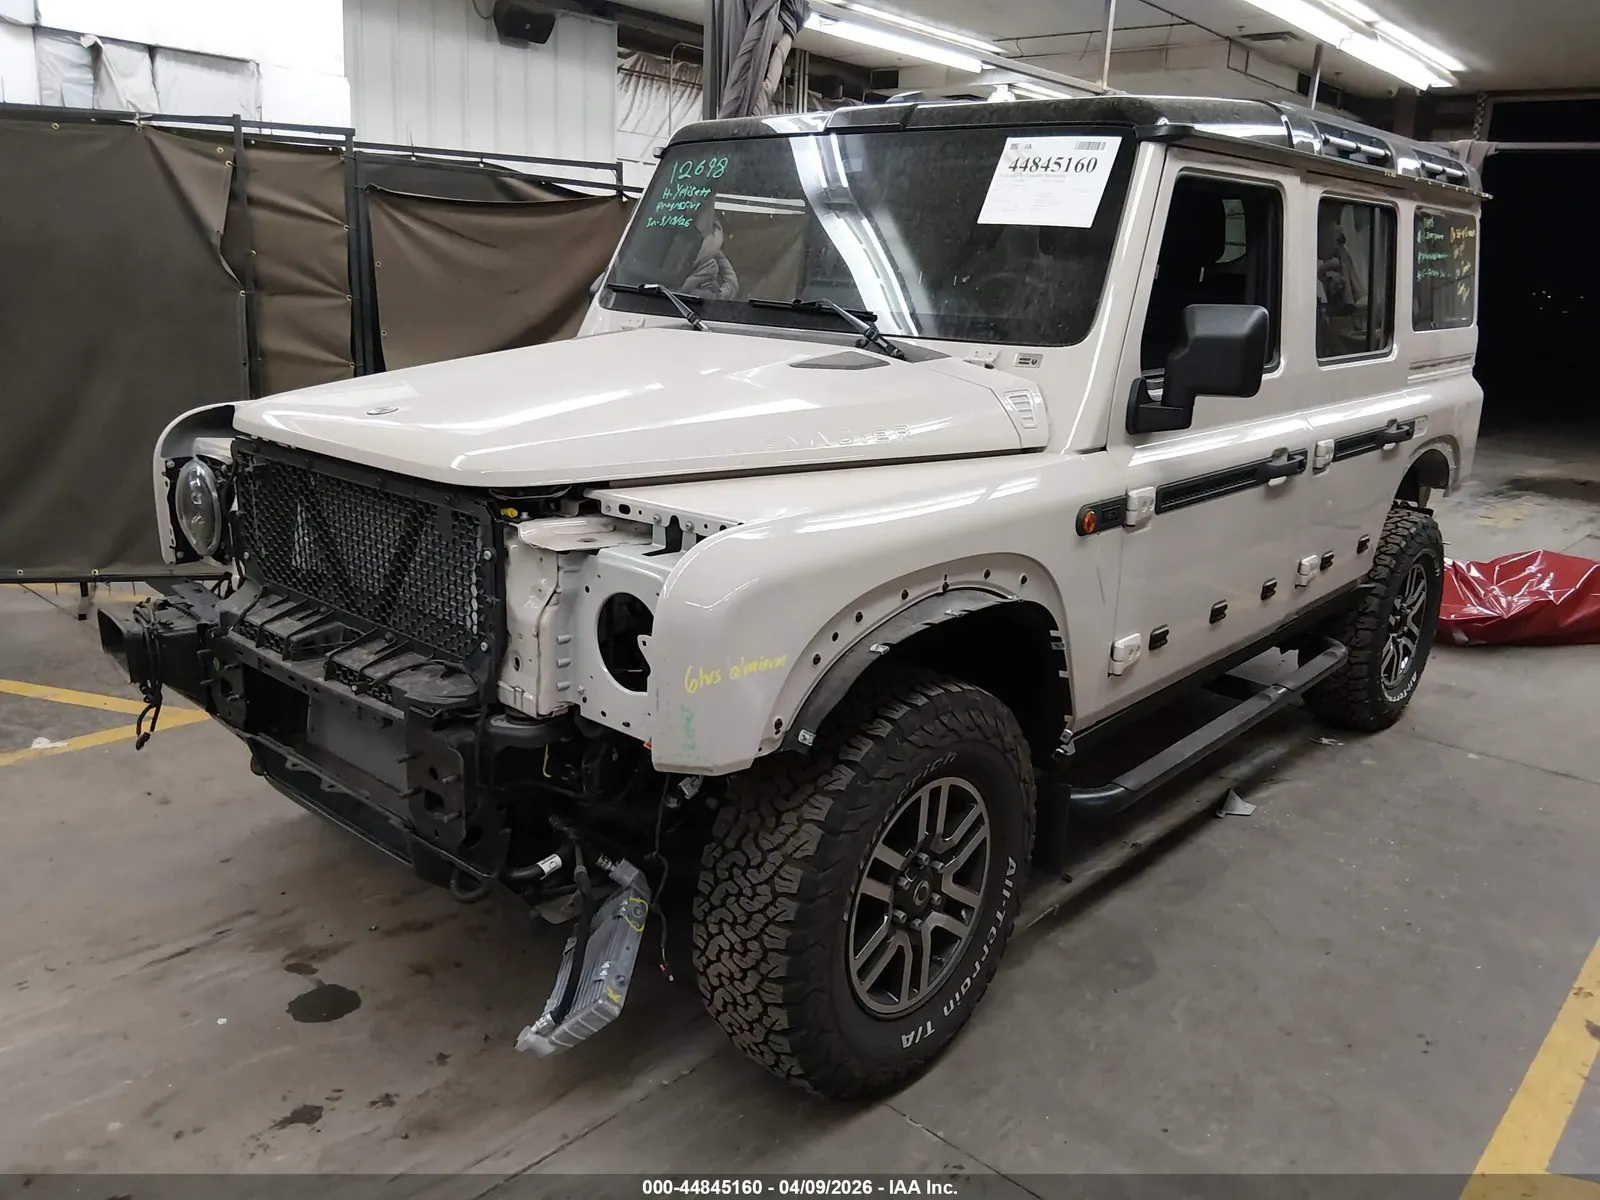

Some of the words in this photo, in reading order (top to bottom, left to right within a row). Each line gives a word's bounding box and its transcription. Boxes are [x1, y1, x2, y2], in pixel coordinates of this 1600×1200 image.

[1008, 156, 1098, 174] 44845160
[942, 855, 1018, 1017] All-Terrain
[900, 1020, 936, 1049] T/A
